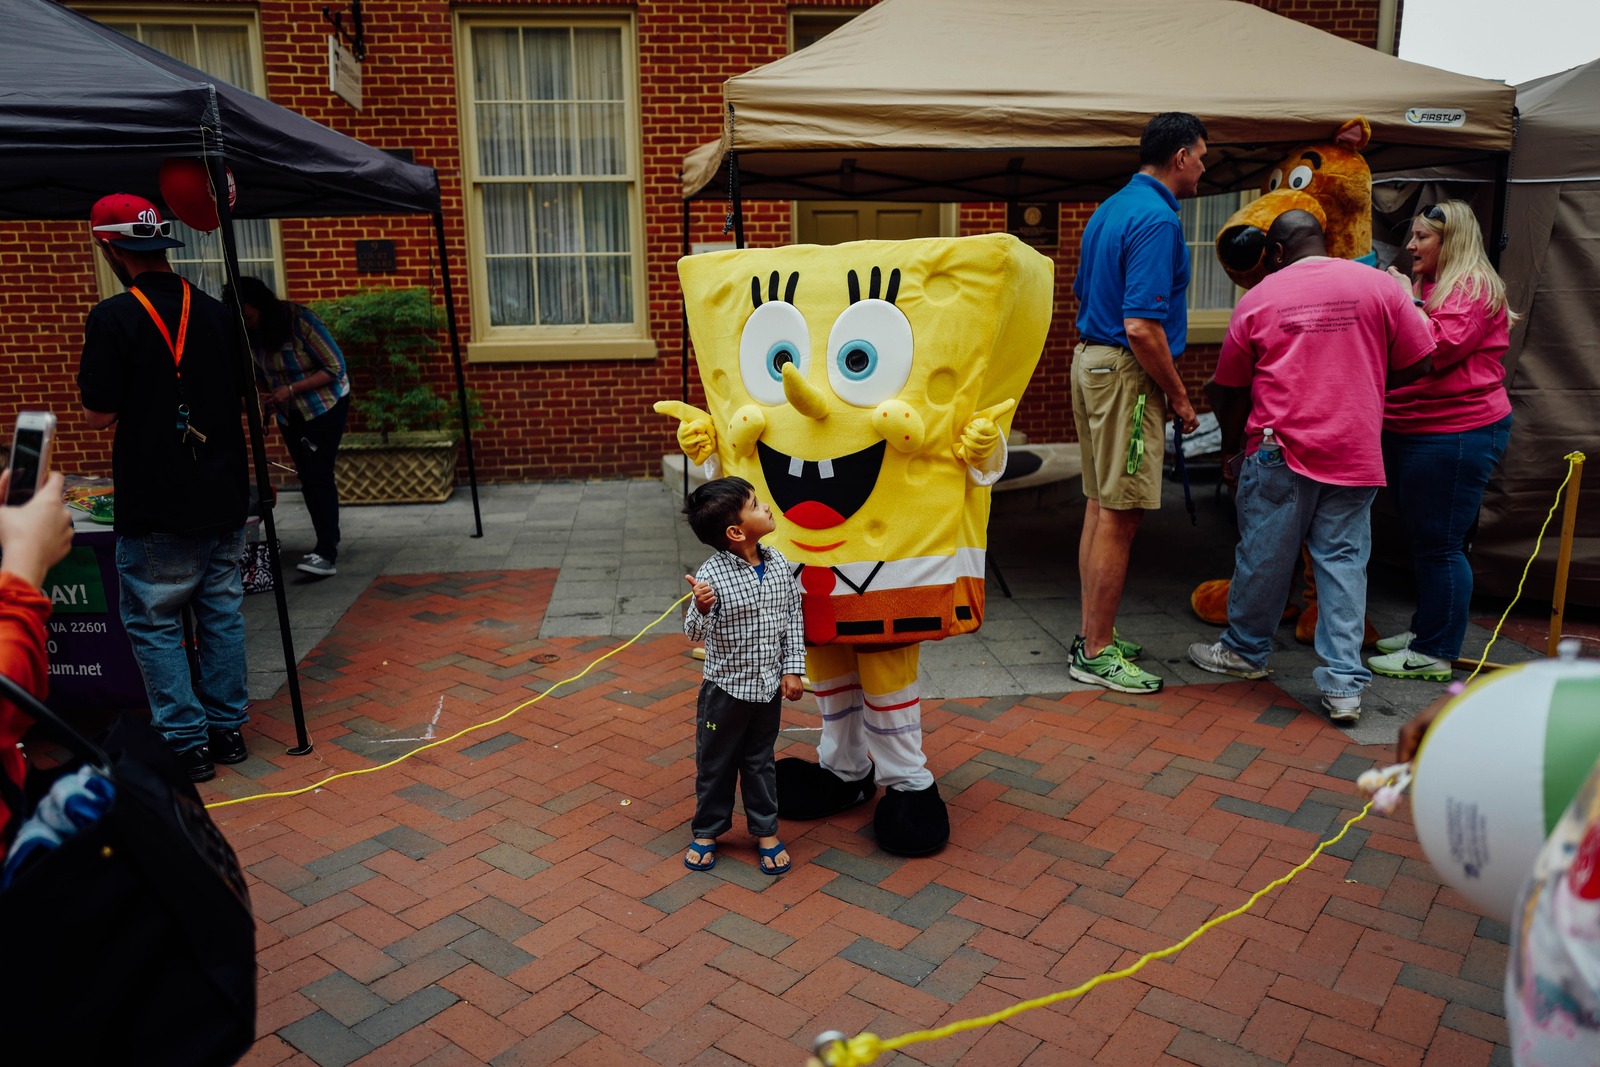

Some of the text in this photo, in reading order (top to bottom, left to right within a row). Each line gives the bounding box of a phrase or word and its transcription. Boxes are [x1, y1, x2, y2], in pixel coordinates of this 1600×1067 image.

[41, 584, 88, 605] AY!
[50, 622, 107, 633] VA 22601
